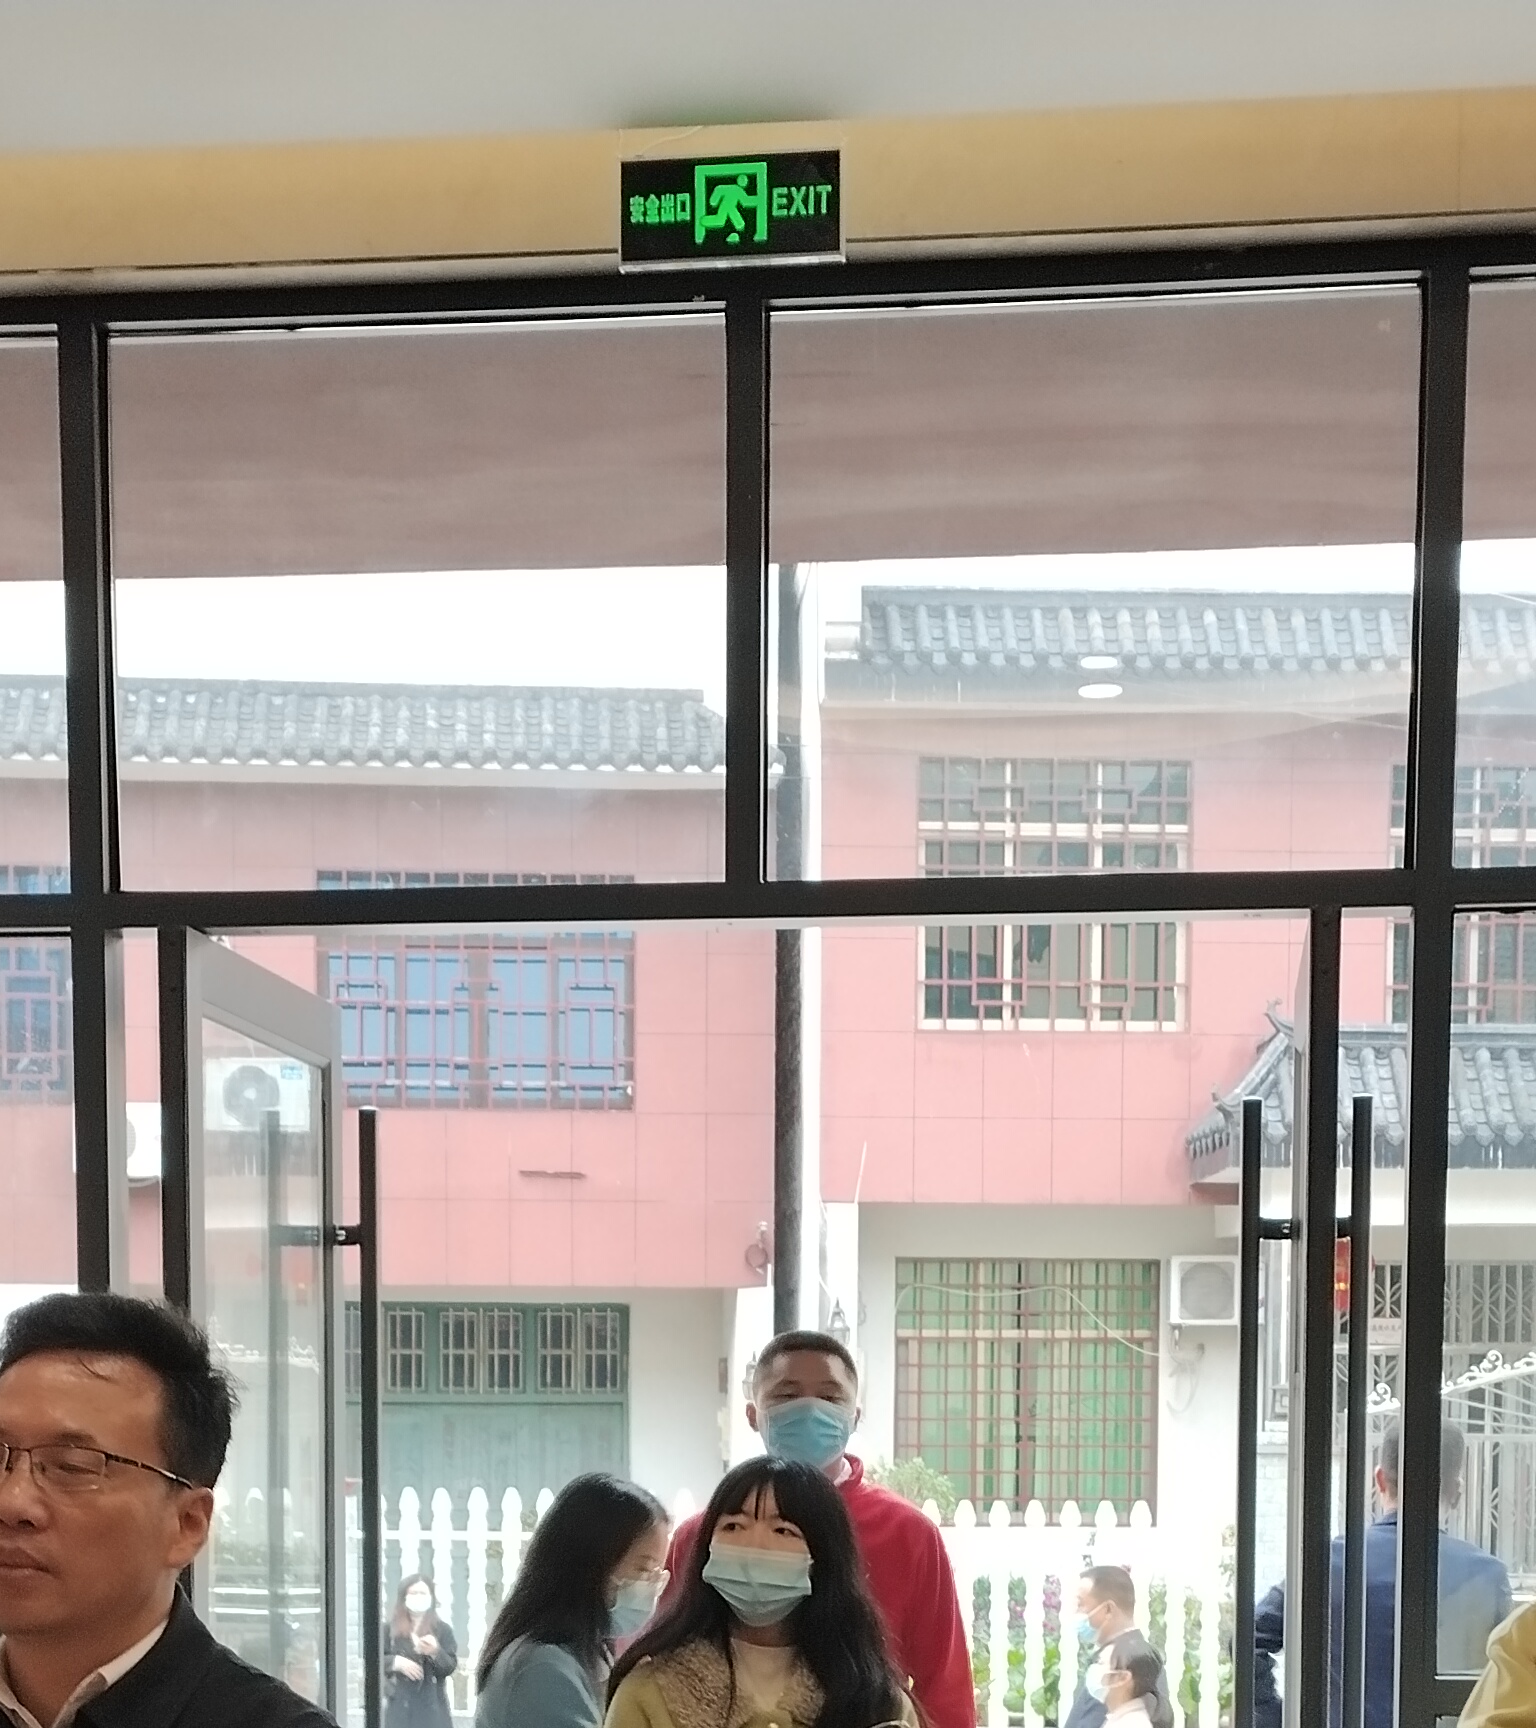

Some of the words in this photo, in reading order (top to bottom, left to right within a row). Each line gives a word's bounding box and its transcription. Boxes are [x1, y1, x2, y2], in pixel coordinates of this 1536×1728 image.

[630, 193, 690, 223] 安全出口
[772, 185, 832, 216] EXIT
